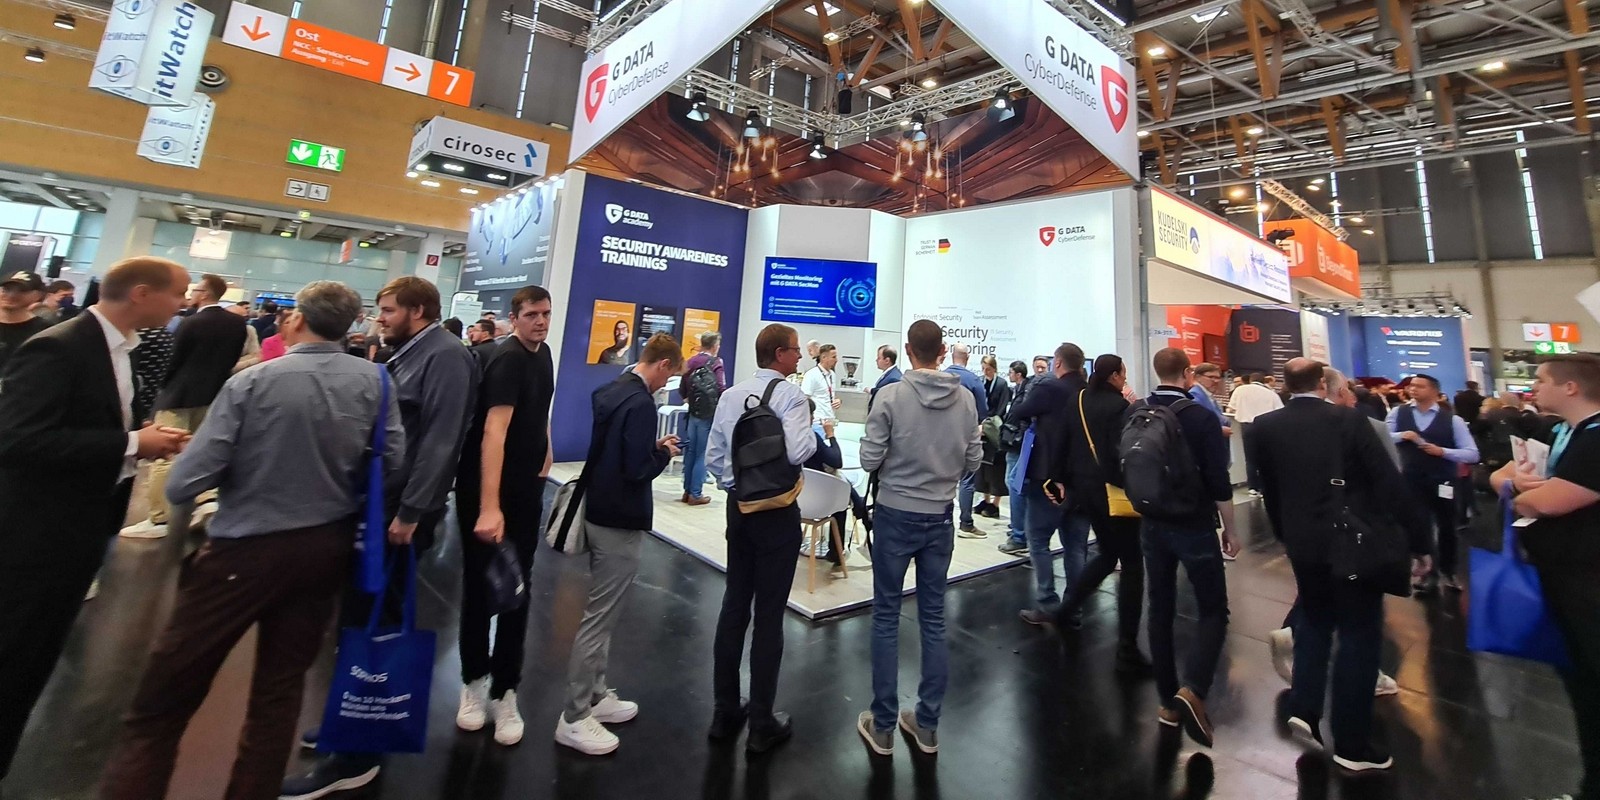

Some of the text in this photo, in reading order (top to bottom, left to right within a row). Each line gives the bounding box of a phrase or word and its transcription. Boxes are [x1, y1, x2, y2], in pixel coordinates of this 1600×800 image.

[295, 28, 320, 42] Ost
[152, 1, 197, 98] itWatch
[612, 41, 654, 80] G DATA
[1045, 35, 1096, 86] G DATA
[444, 71, 461, 96] 7
[608, 61, 669, 105] CyberDefense
[1024, 53, 1097, 111] CyberDefense
[443, 136, 517, 163] cirosec
[622, 217, 654, 230] academy
[623, 209, 649, 221] G DATA
[1157, 209, 1188, 237] KUDELSKI
[1057, 234, 1096, 245] CyberDefense
[1058, 225, 1086, 235] G DATA
[1159, 226, 1188, 251] SECURITY
[600, 249, 668, 271] TRAININGS
[601, 235, 729, 267] SECURITY AWARENESS
[794, 274, 823, 283] Monitoring
[939, 313, 963, 323] Security
[941, 325, 988, 343] Security
[1557, 326, 1570, 339] 7
[350, 665, 388, 683] SOPHOS
